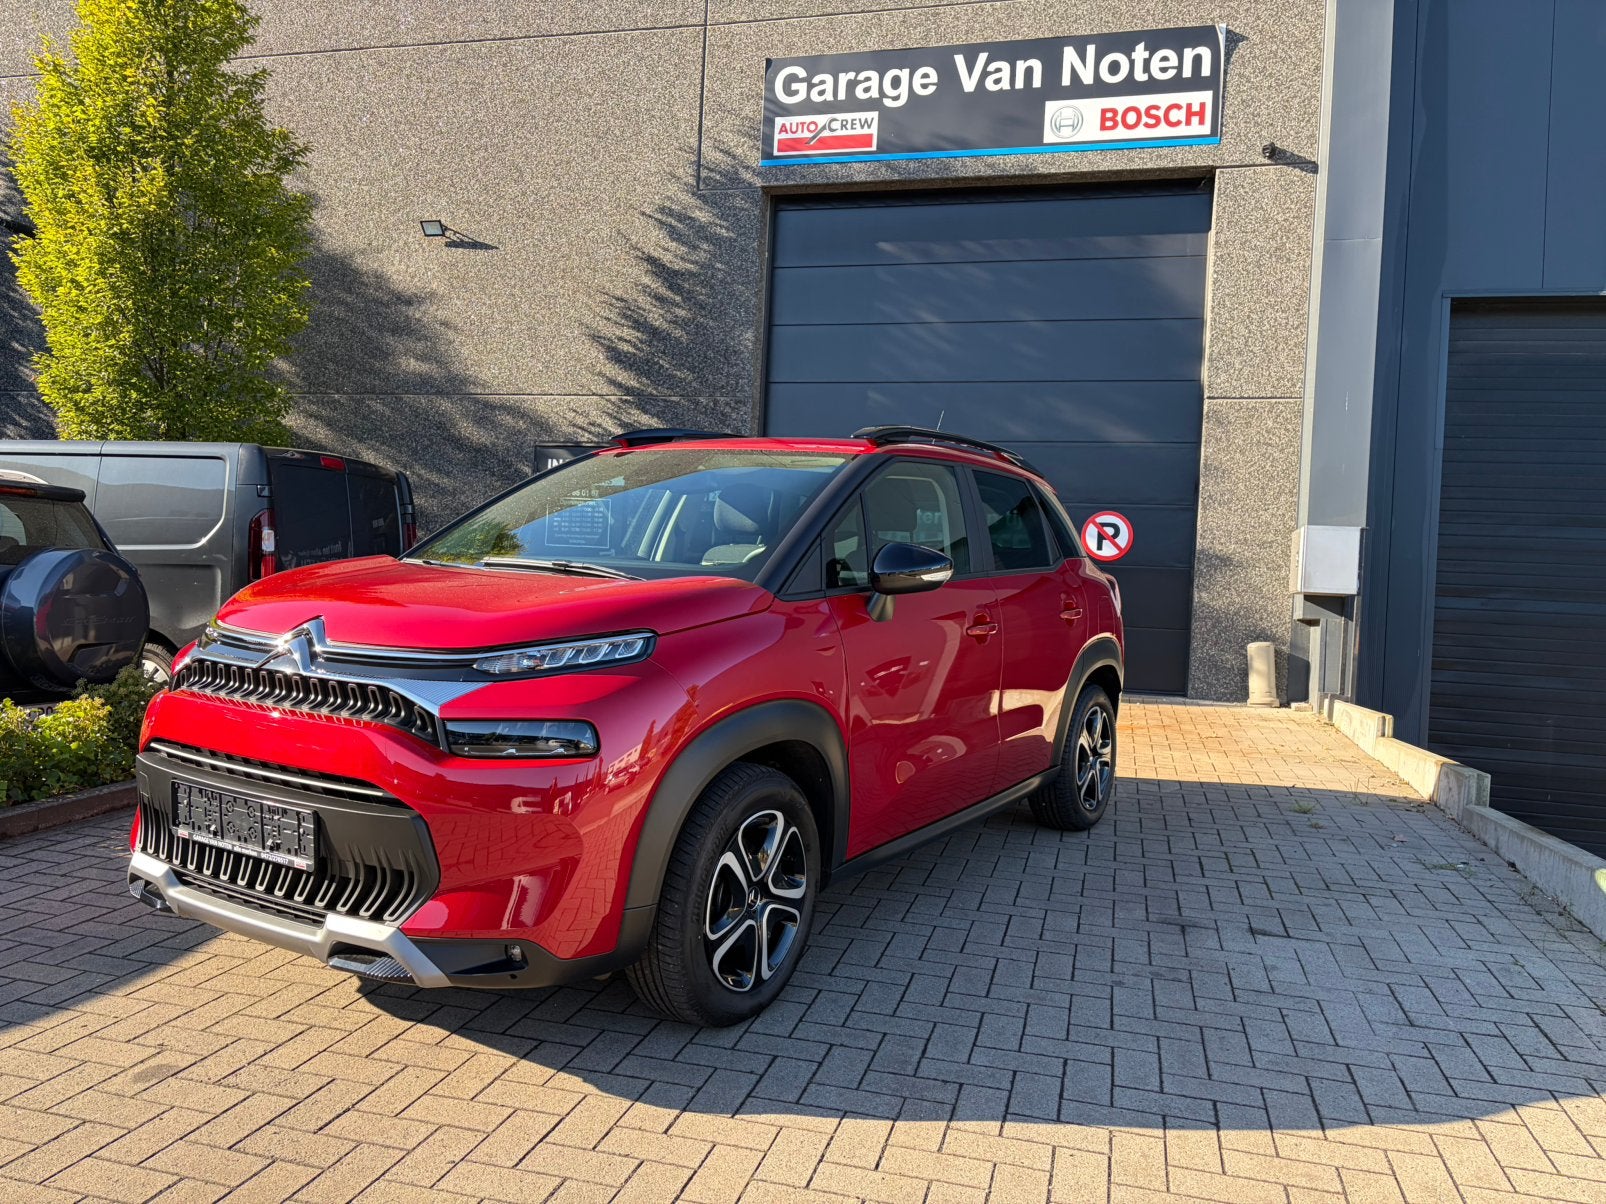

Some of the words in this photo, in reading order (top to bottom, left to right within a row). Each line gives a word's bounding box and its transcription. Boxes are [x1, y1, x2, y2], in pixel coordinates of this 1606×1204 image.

[774, 66, 939, 108] Garage
[953, 51, 1043, 93] Van
[1061, 42, 1212, 87] Noten
[1099, 102, 1207, 132] BOSCH
